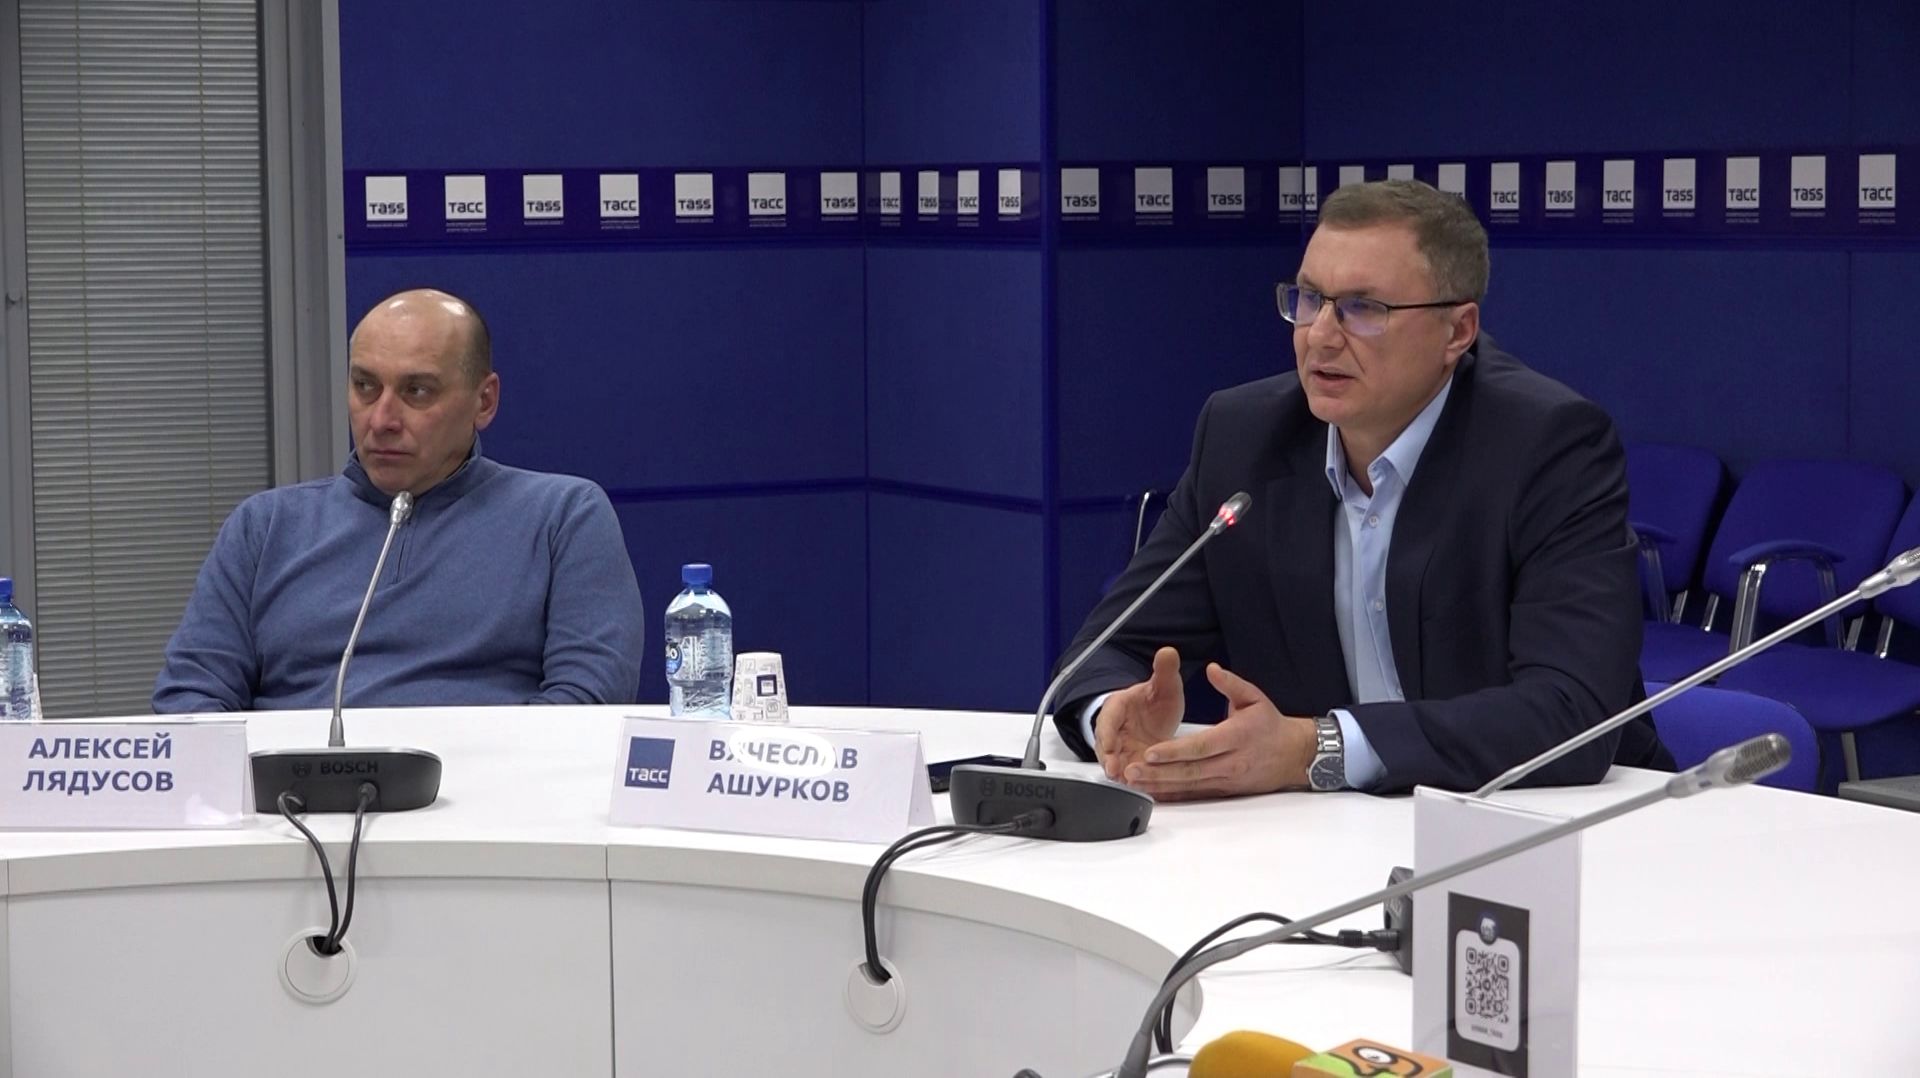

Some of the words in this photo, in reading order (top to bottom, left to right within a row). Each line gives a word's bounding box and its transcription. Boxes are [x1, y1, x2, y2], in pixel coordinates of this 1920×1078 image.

[28, 732, 172, 759] АЛЕКСЕЙ
[321, 761, 379, 774] BOSCH
[22, 770, 174, 796] ЛЯДУСОВ
[706, 772, 850, 803] АШУРКОВ
[1003, 782, 1056, 800] BOSCH
